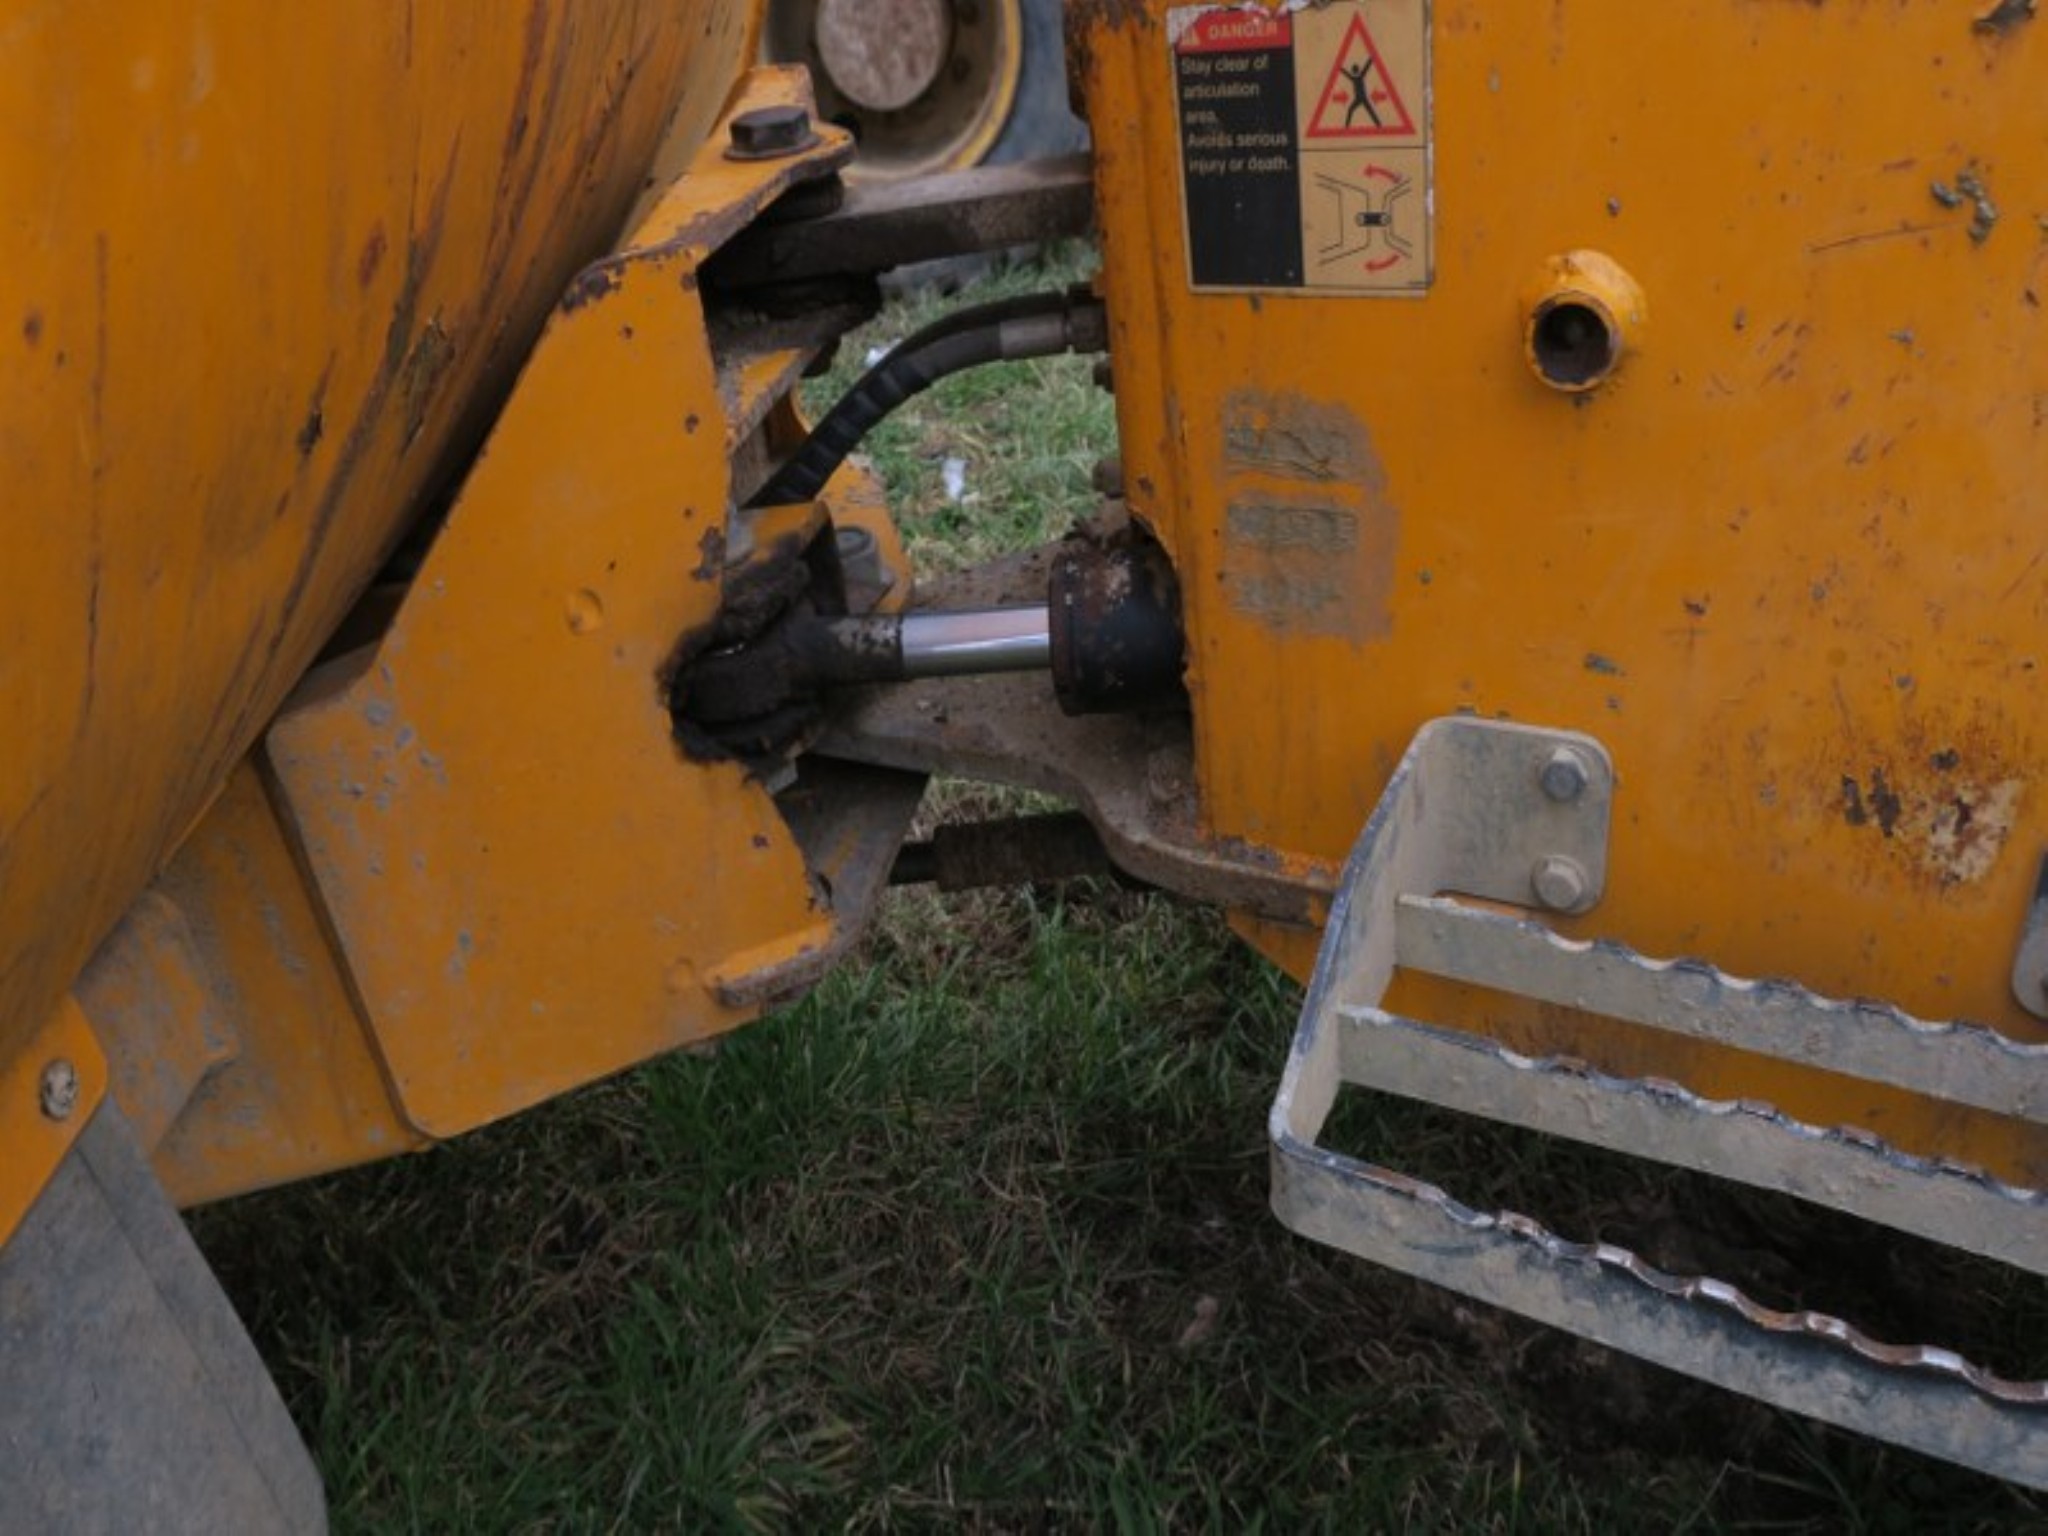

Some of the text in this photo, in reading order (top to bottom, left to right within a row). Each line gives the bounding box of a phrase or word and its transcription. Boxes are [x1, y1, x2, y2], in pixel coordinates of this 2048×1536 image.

[1208, 20, 1278, 40] DANGER
[1181, 54, 1269, 77] Stay clear of
[1184, 82, 1260, 98] articulation
[1236, 132, 1288, 147] serious
[1189, 156, 1226, 175] injury
[1228, 159, 1244, 172] or
